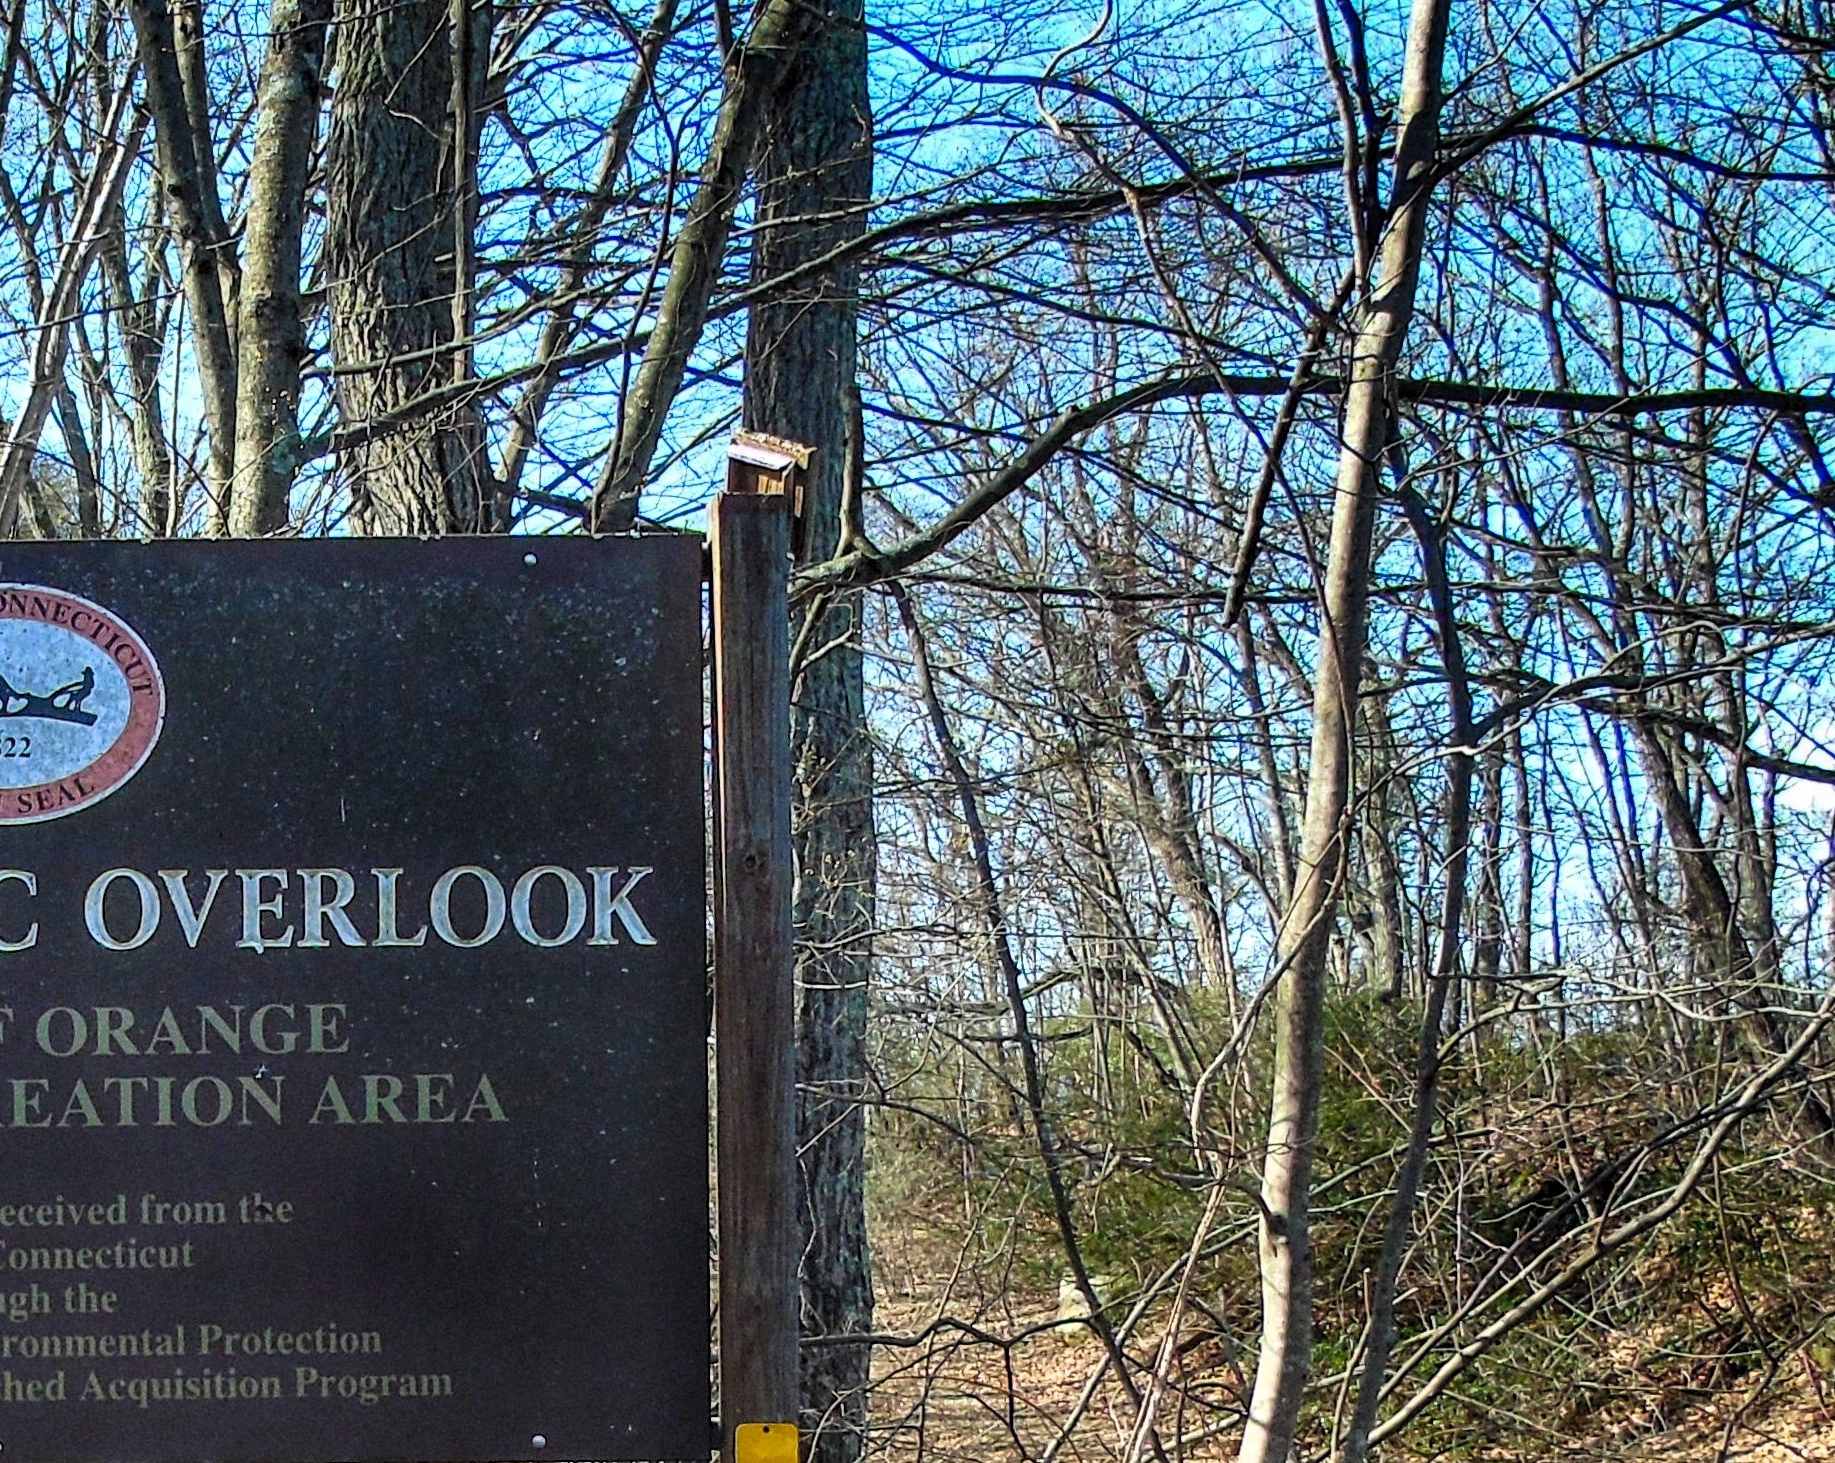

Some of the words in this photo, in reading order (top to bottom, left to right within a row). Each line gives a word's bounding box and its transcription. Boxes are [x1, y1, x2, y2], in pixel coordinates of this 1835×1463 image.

[17, 776, 96, 815] SEAL
[83, 865, 658, 952] OVERLOOK
[35, 1004, 350, 1057] ORANGE
[308, 1073, 509, 1124] AREA
[139, 1193, 228, 1226] from
[238, 1191, 295, 1225] the
[65, 1281, 119, 1315] the
[197, 1321, 385, 1357] Protection
[79, 1367, 281, 1408] Acquisition
[294, 1365, 455, 1407] Program
